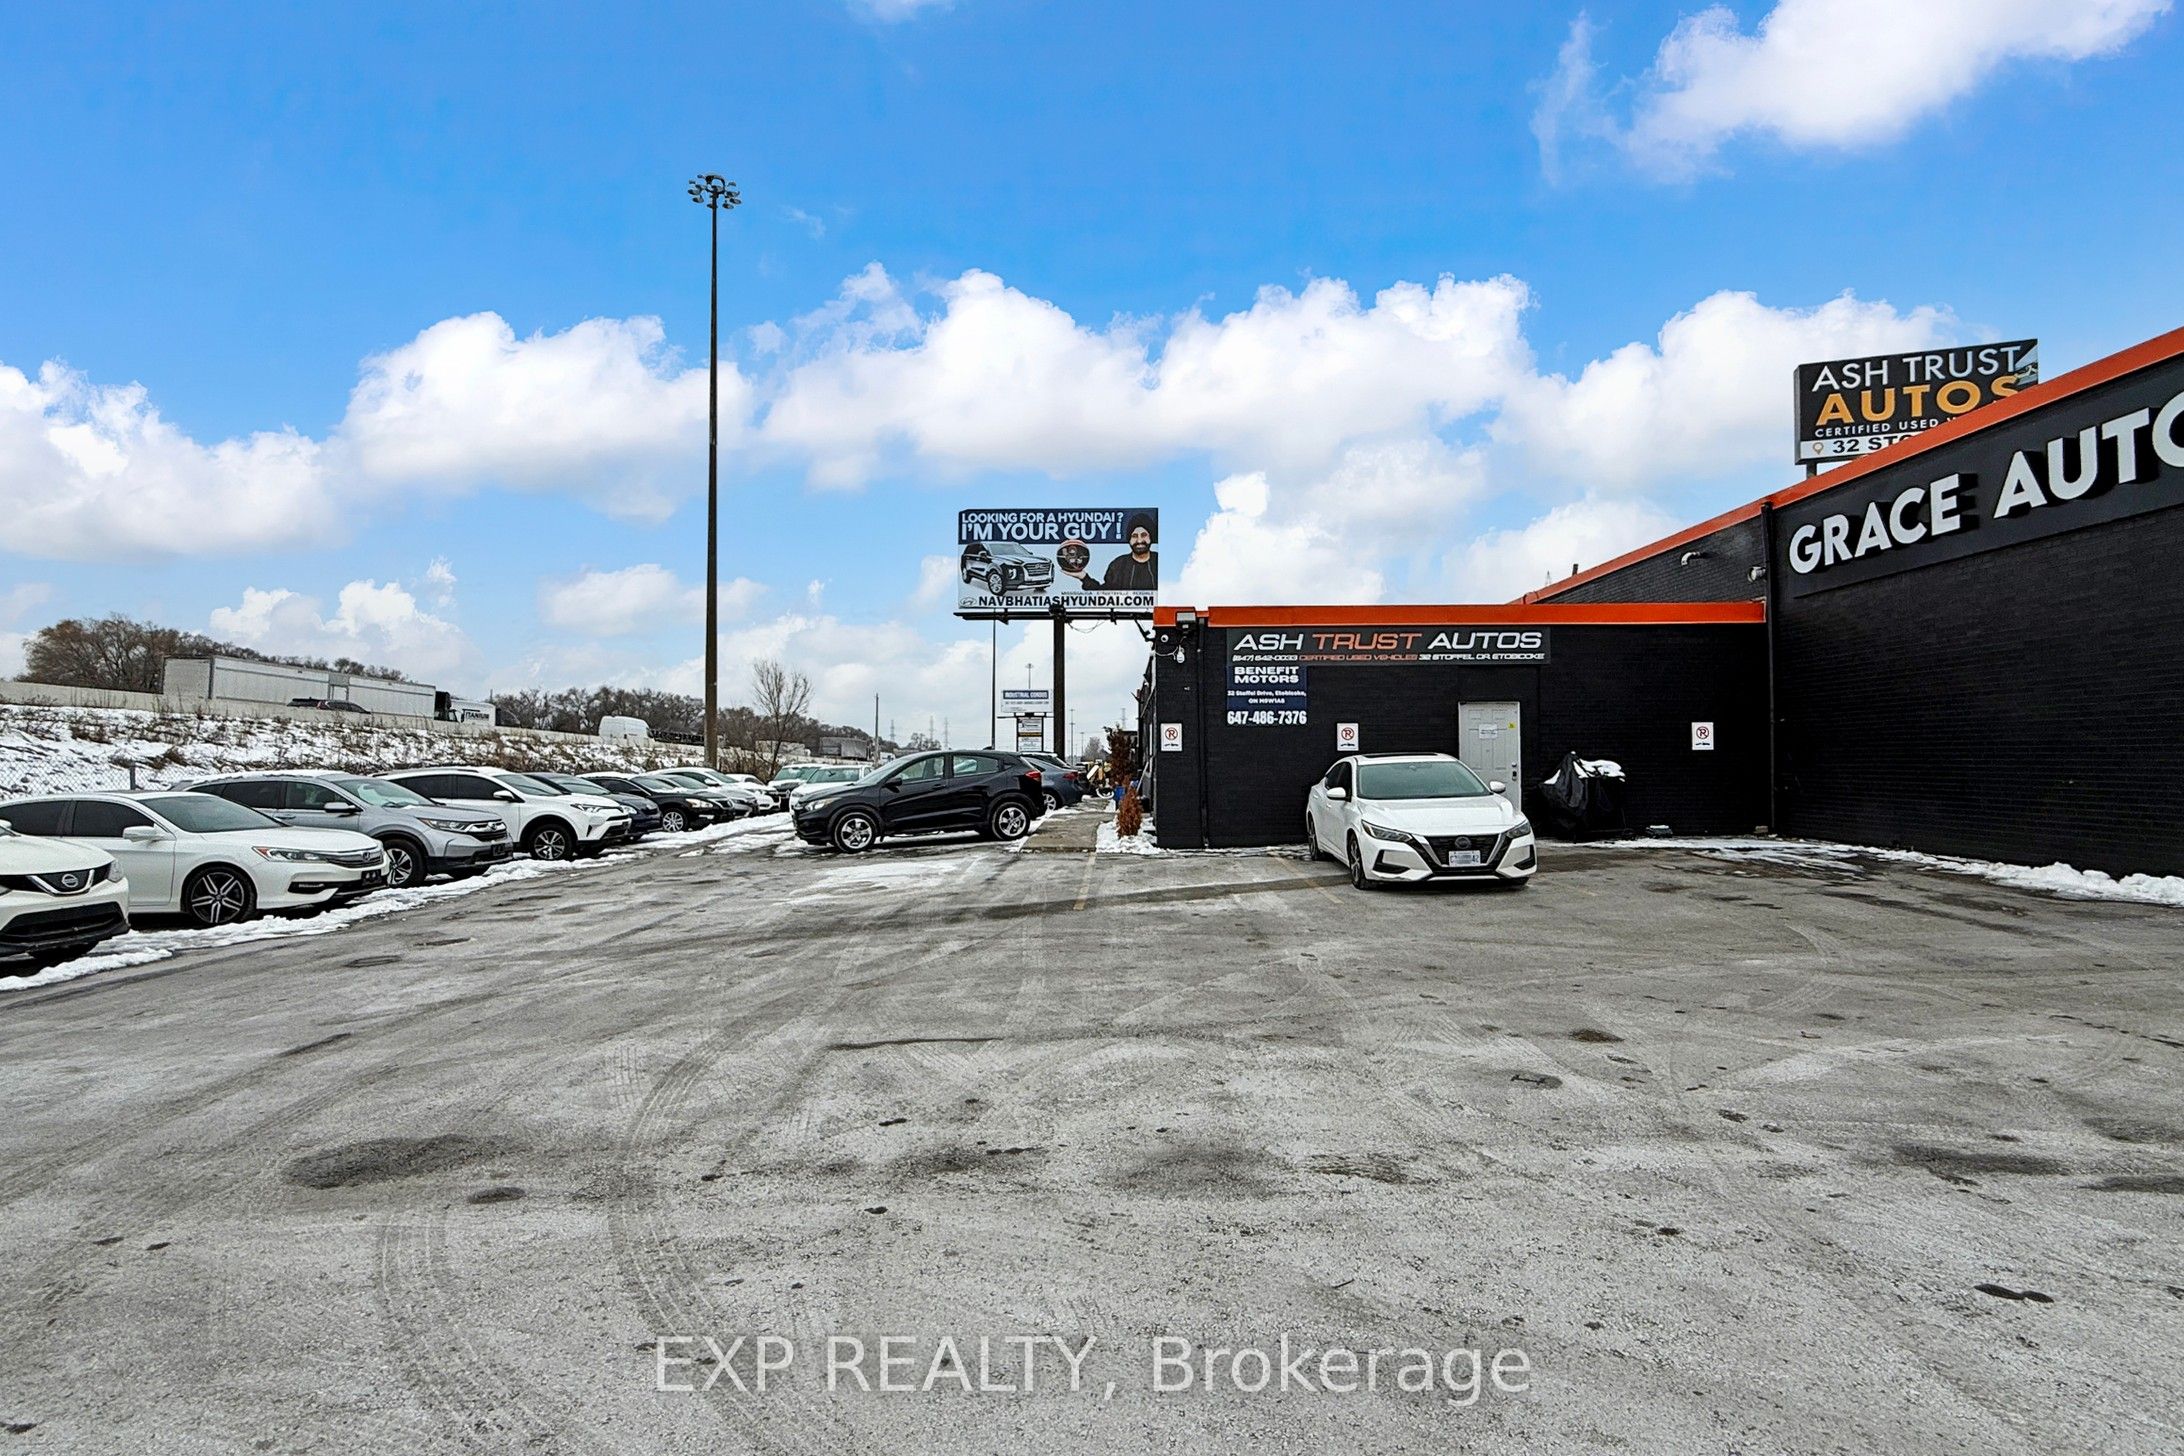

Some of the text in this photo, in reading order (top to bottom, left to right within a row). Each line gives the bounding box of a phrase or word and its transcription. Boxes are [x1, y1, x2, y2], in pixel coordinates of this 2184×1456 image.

[1812, 345, 2021, 392] ASH TRUST
[1816, 375, 2019, 426] AUTOS
[1815, 422, 1891, 438] CERTIFIED
[1899, 418, 1939, 431] USED
[1832, 439, 1860, 454] 32
[962, 512, 1018, 523] LOOKING
[1020, 512, 1045, 523] FOR
[1046, 512, 1056, 522] A
[1789, 473, 1961, 574] GRACE
[962, 523, 993, 540] I'M
[1001, 523, 1058, 540] YOUR
[978, 596, 1154, 606] NAVBHATIASHYUNDAI.COM
[1234, 632, 1542, 651] ASH TRUST AUTOS
[1234, 666, 1300, 675] BENEFIT
[1234, 675, 1300, 684] MOTORS
[1227, 710, 1307, 725] 647-486-7376
